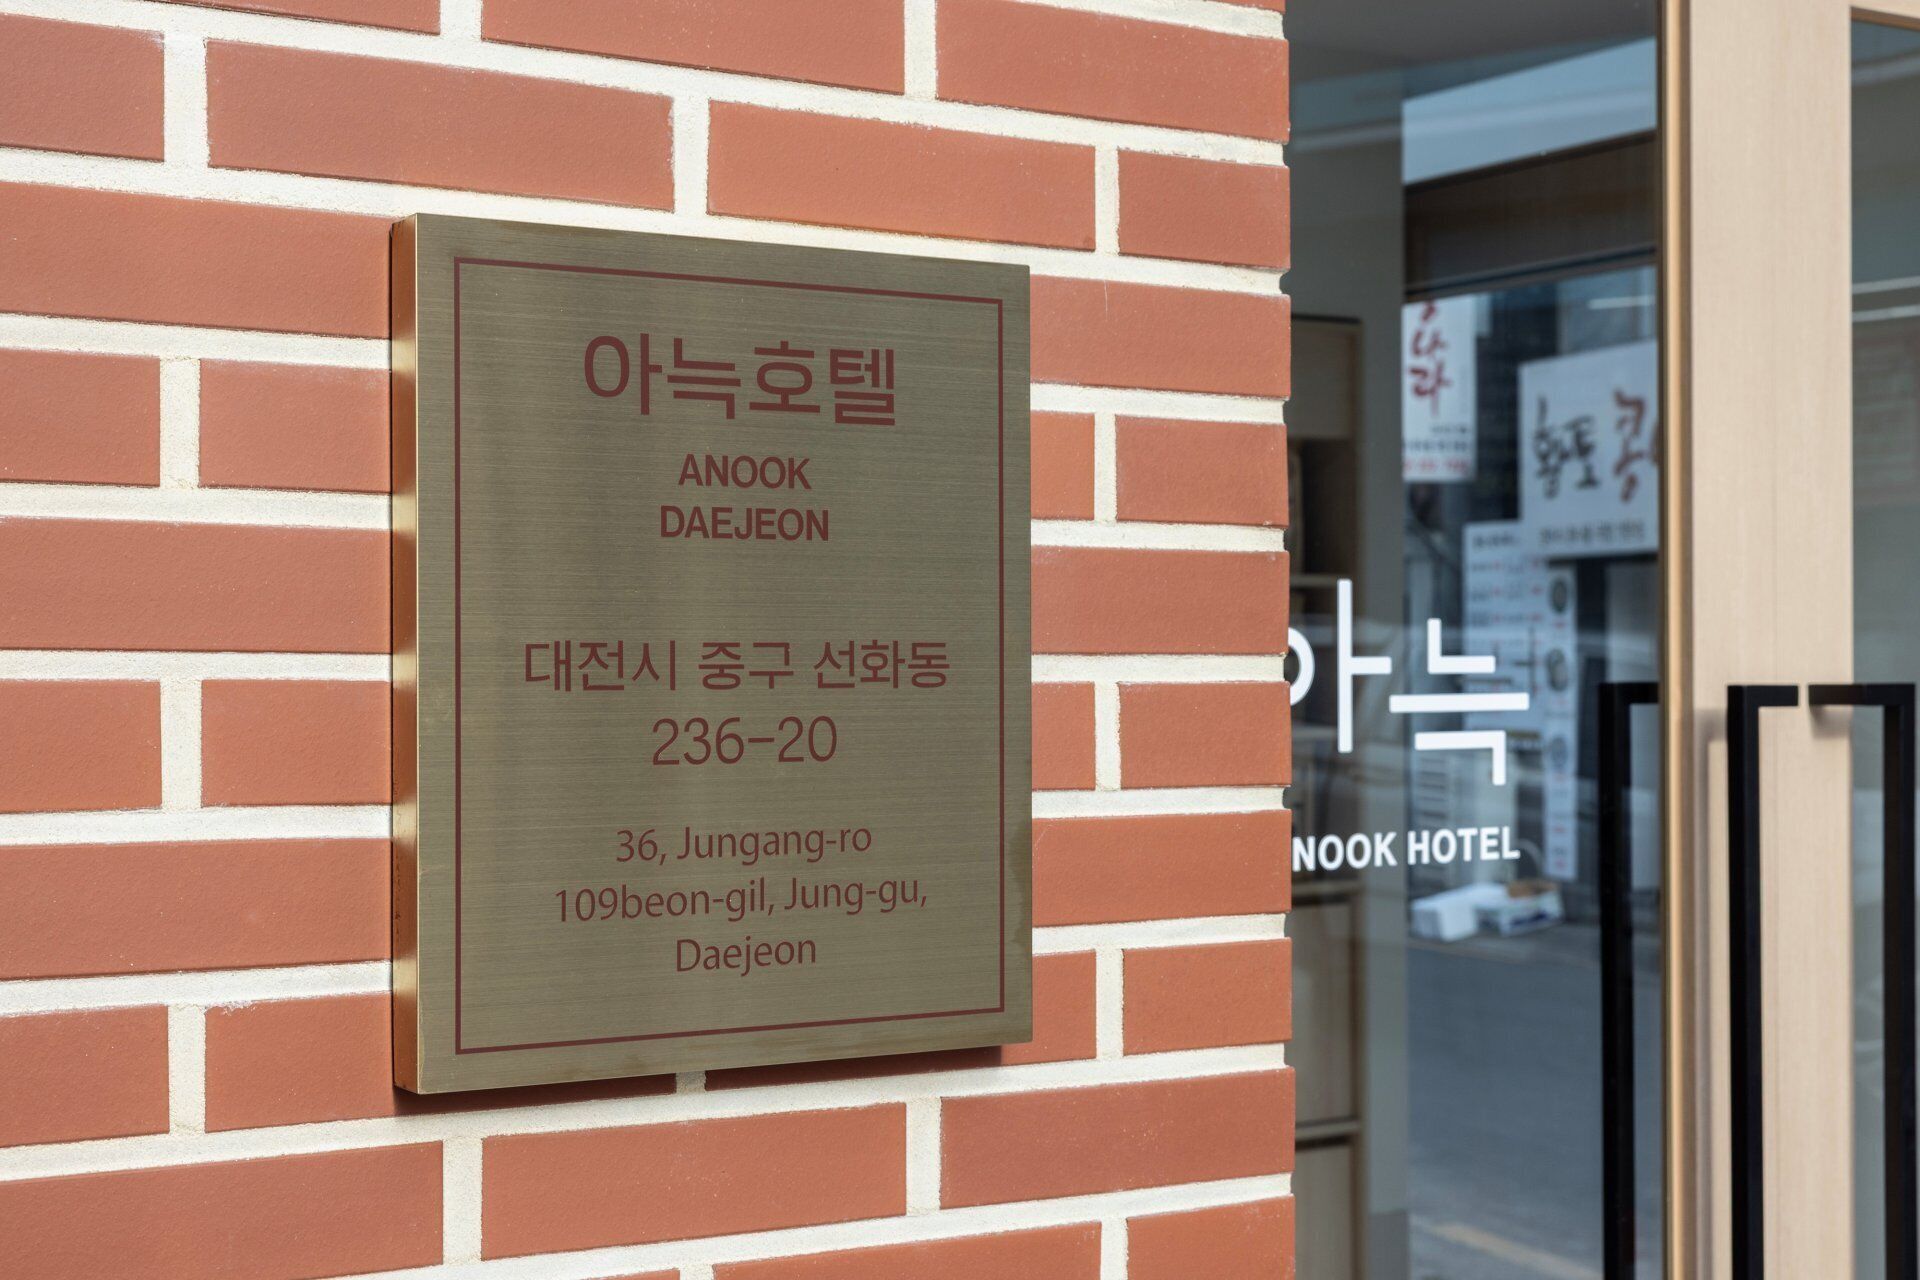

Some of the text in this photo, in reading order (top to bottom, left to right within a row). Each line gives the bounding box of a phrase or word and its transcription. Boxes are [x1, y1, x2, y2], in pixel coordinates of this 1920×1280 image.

[584, 333, 896, 426] 아늑호텔
[678, 453, 811, 490] ANOOK
[660, 505, 829, 541] DAEJEON
[524, 639, 951, 692] 대전시 중구 선화동
[1289, 579, 1530, 786] 아늑
[652, 716, 837, 767] 236-20
[616, 827, 872, 866] 36, Jungang-ro
[1292, 826, 1521, 872] NOOK HOTEL
[555, 877, 927, 922] 109beon-gil, Jung-gu,
[675, 936, 816, 977] Daejeon
